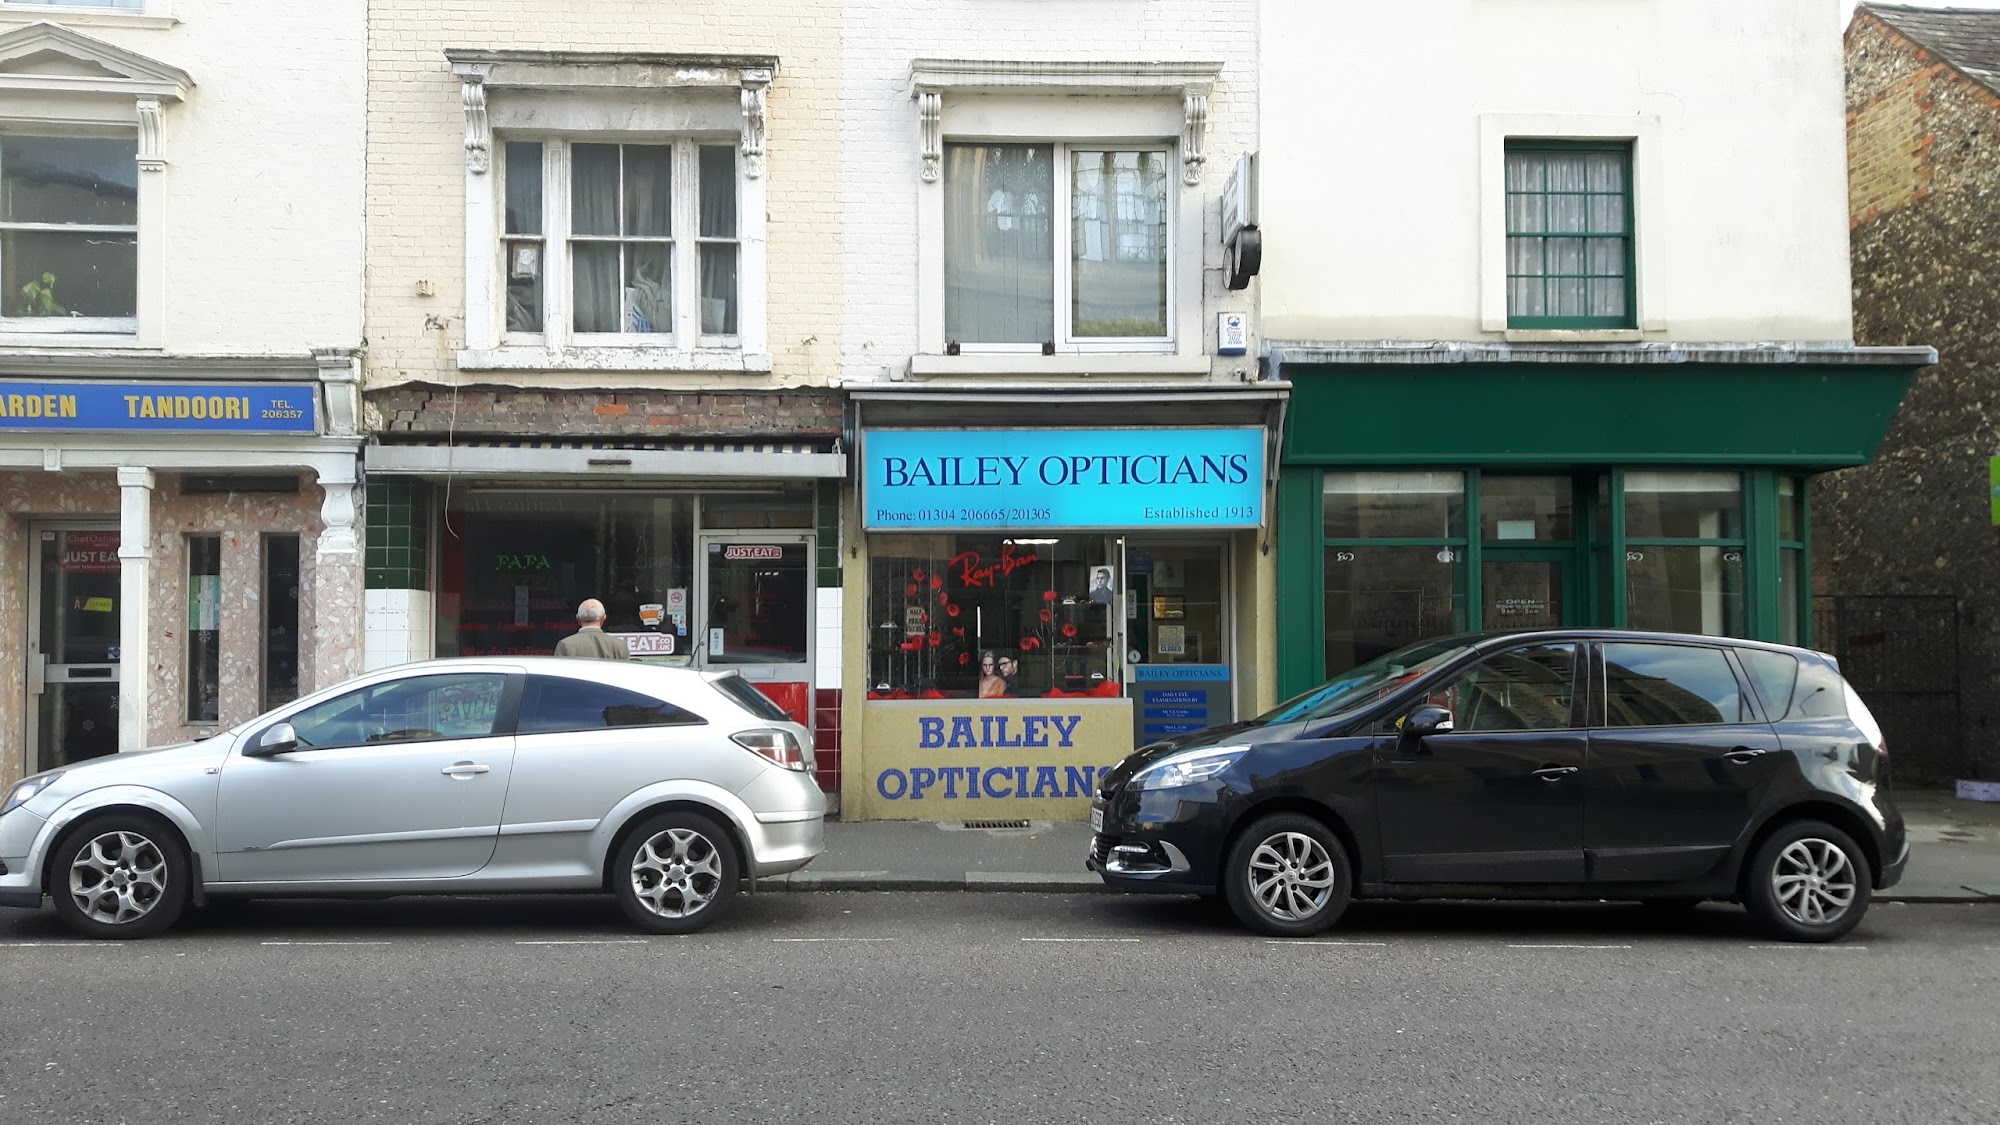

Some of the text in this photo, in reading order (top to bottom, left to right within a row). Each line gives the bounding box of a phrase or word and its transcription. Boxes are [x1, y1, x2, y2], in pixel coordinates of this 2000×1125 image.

[124, 395, 250, 420] TANDOORI
[270, 400, 294, 409] TEL.
[261, 410, 303, 419] 206357
[883, 453, 1248, 487] BAILEY OPTICIANS
[876, 508, 1051, 522] Phone: 01304 206665/201305
[1143, 506, 1254, 519] Established 1913
[63, 551, 119, 562] JUST EA
[728, 547, 754, 558] JUST
[754, 547, 772, 557] EAT
[948, 541, 1039, 587] Ray-Ban
[627, 636, 660, 651] EAT
[918, 715, 1082, 749] BAILEY
